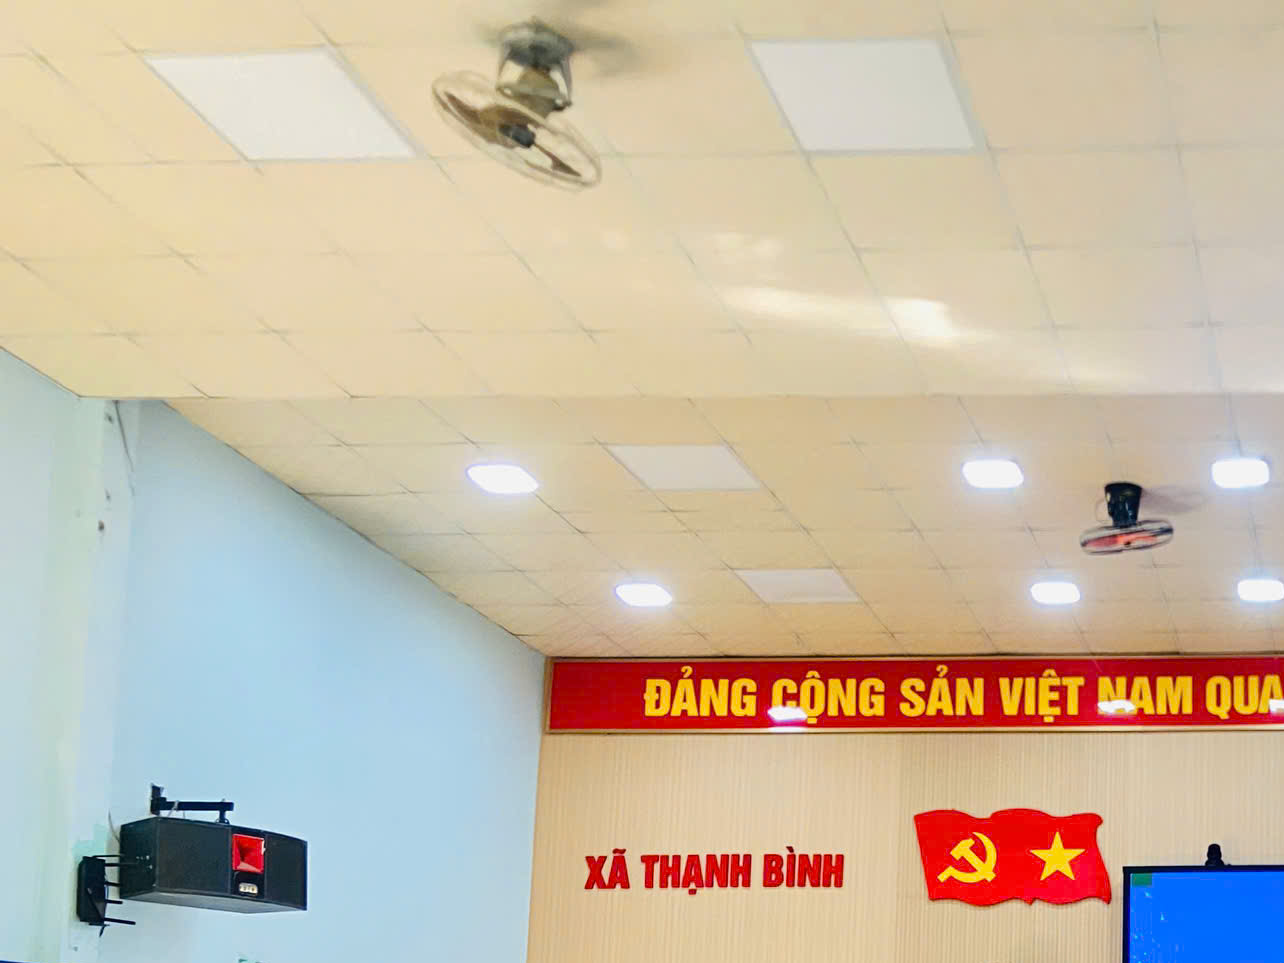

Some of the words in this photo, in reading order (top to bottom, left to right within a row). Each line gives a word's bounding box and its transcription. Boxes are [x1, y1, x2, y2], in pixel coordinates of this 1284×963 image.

[644, 665, 758, 717] ĐẢNG
[771, 670, 886, 725] CỘNG
[899, 664, 985, 718] SẢN
[998, 668, 1085, 723] VIỆT
[1096, 675, 1193, 716] NAM
[584, 848, 631, 890] XÃ
[640, 853, 752, 896] THẠNH
[762, 845, 845, 888] BÌNH
